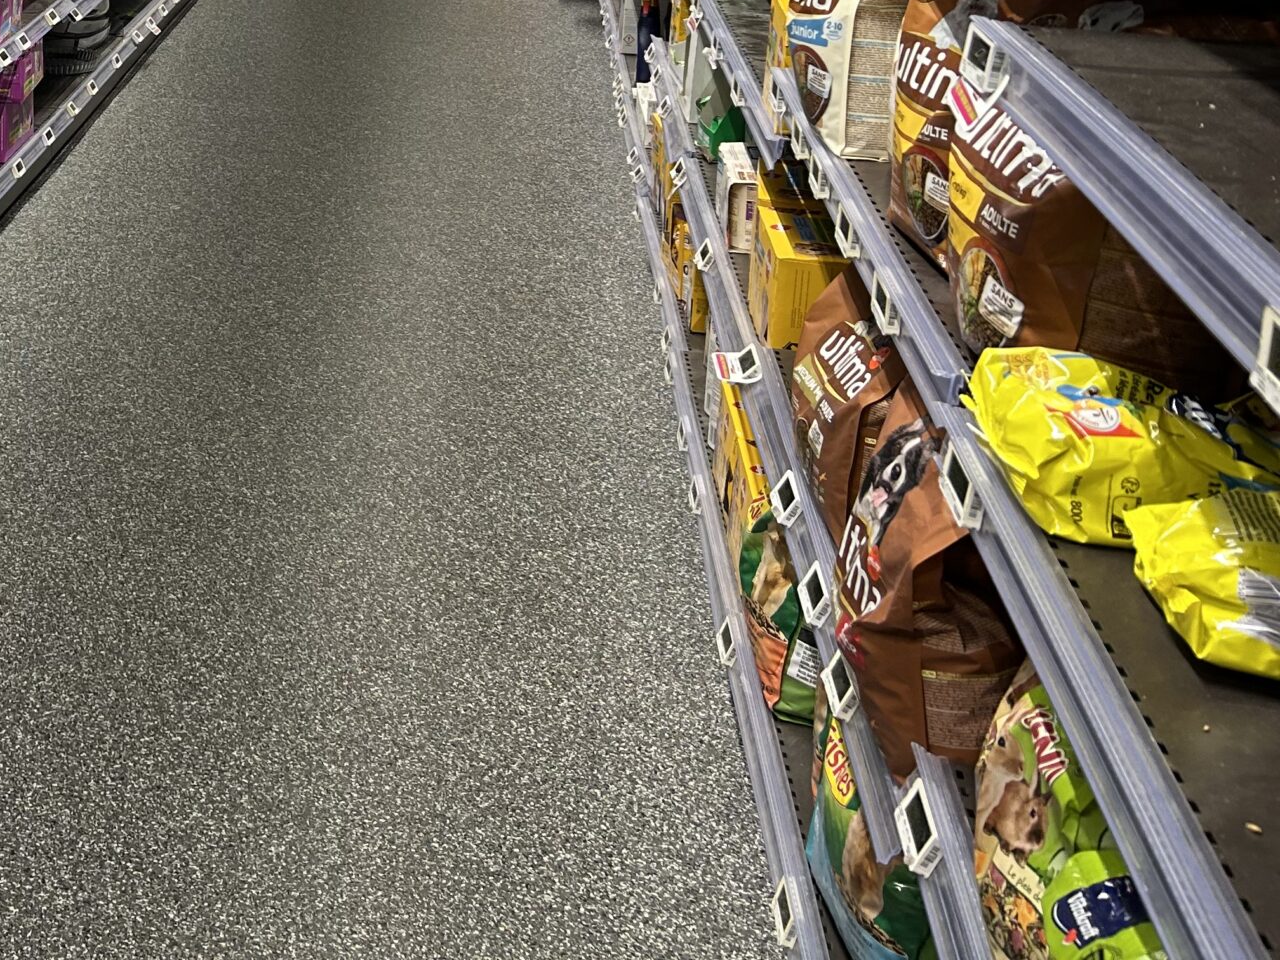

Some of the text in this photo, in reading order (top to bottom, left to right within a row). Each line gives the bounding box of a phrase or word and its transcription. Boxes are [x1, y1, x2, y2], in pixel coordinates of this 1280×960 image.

[790, 23, 820, 41] junior
[810, 66, 828, 80] SANS
[980, 203, 1020, 240] ADULTE
[990, 282, 1017, 309] SANS
[819, 329, 873, 400] ultima
